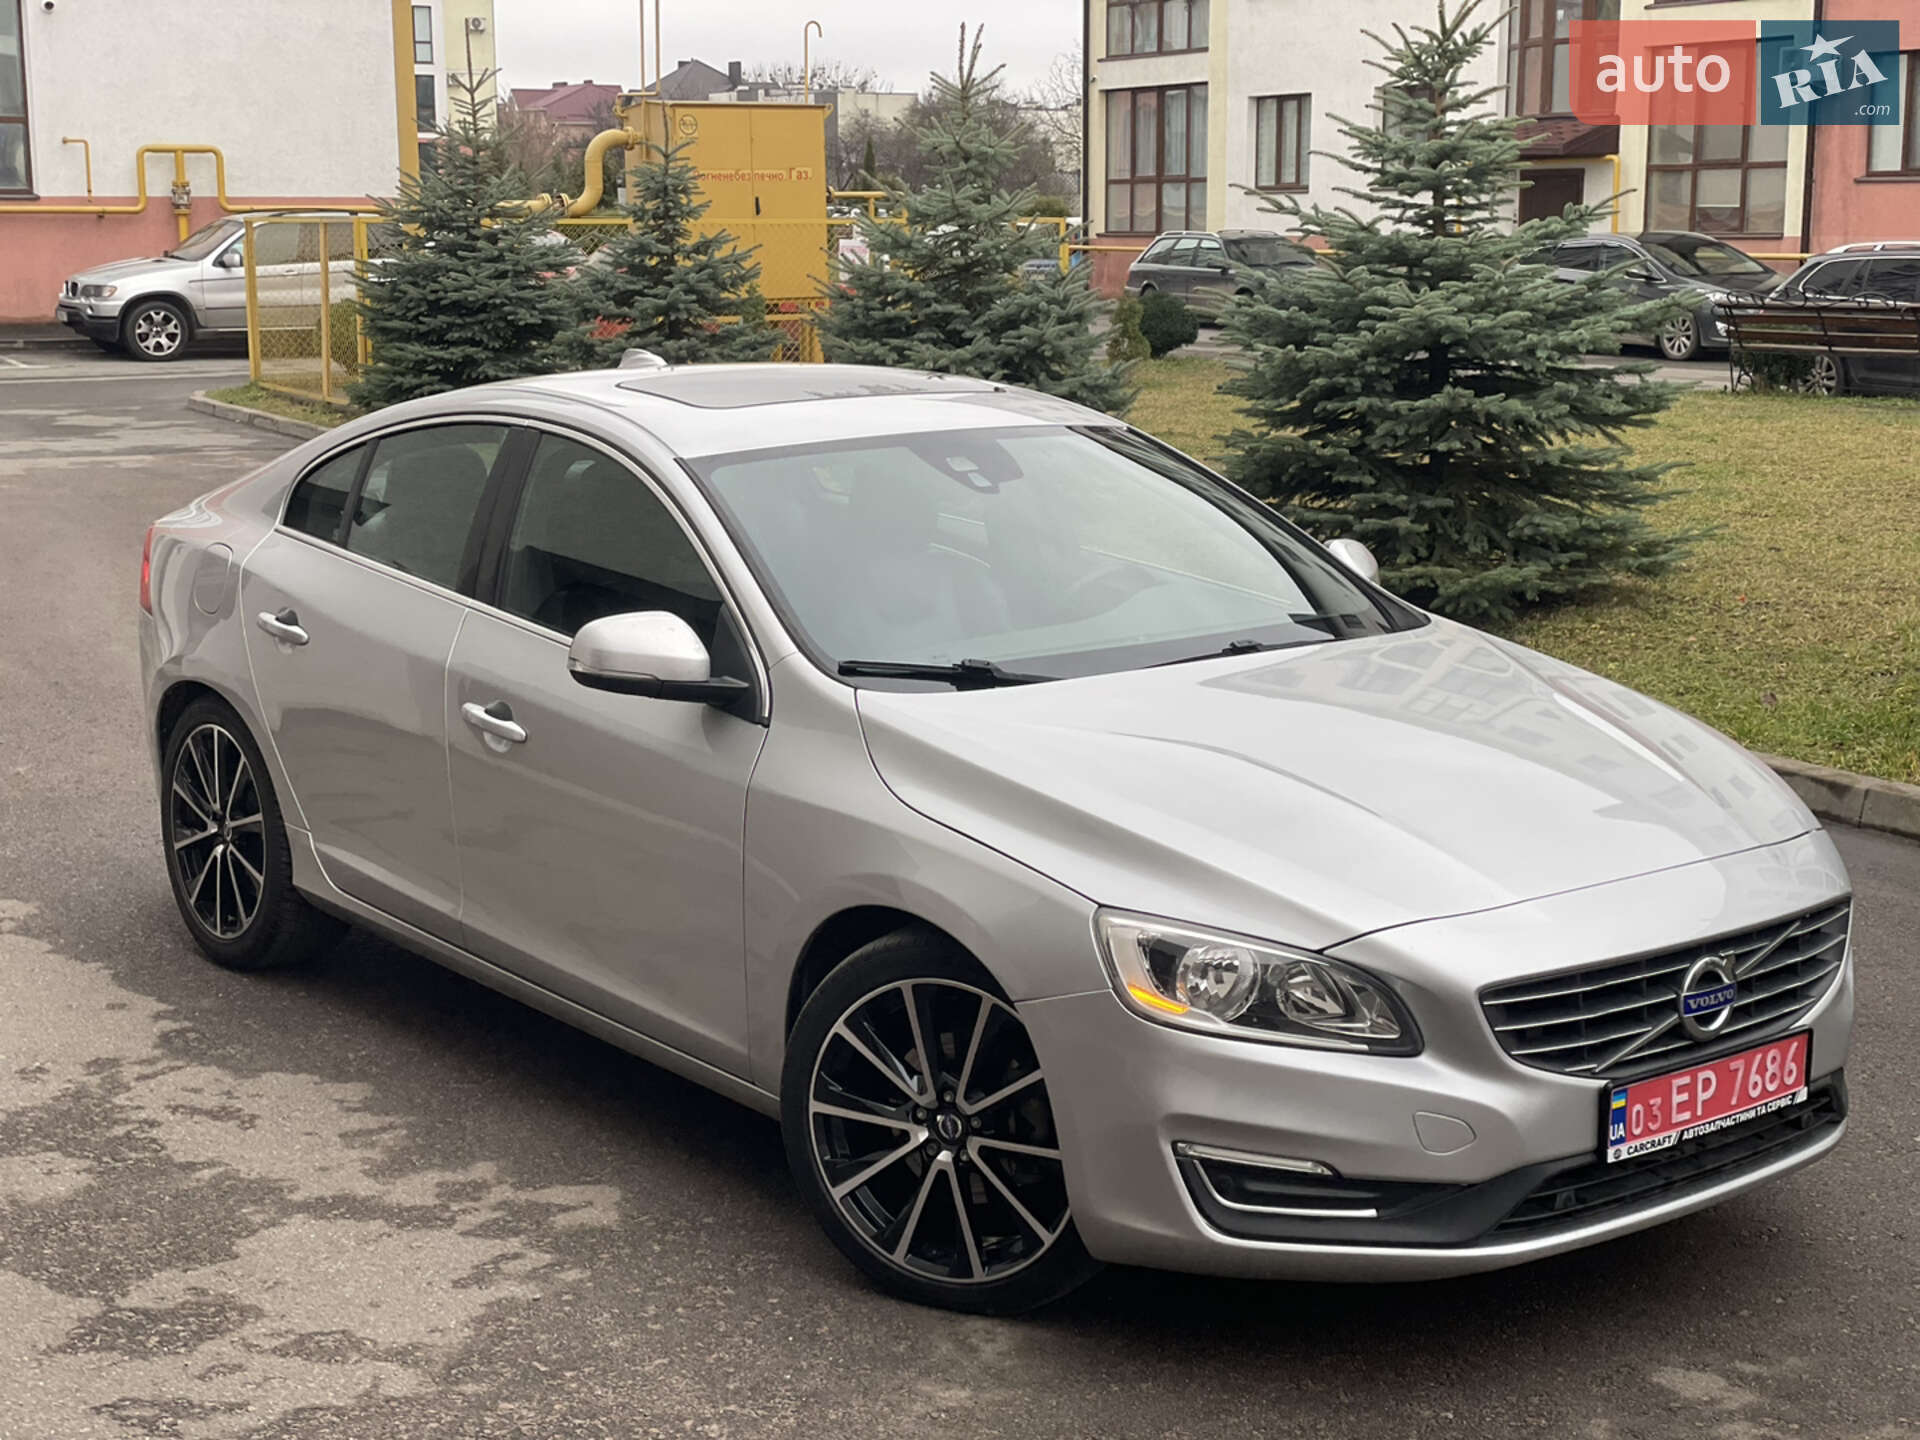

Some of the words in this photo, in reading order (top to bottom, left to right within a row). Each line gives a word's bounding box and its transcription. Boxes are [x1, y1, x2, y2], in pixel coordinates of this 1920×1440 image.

[1687, 988, 1734, 1009] VOLVO
[1631, 1097, 1662, 1136] 03
[1671, 1070, 1718, 1125] EP
[1729, 1041, 1799, 1106] 7686
[1609, 1122, 1626, 1141] UA
